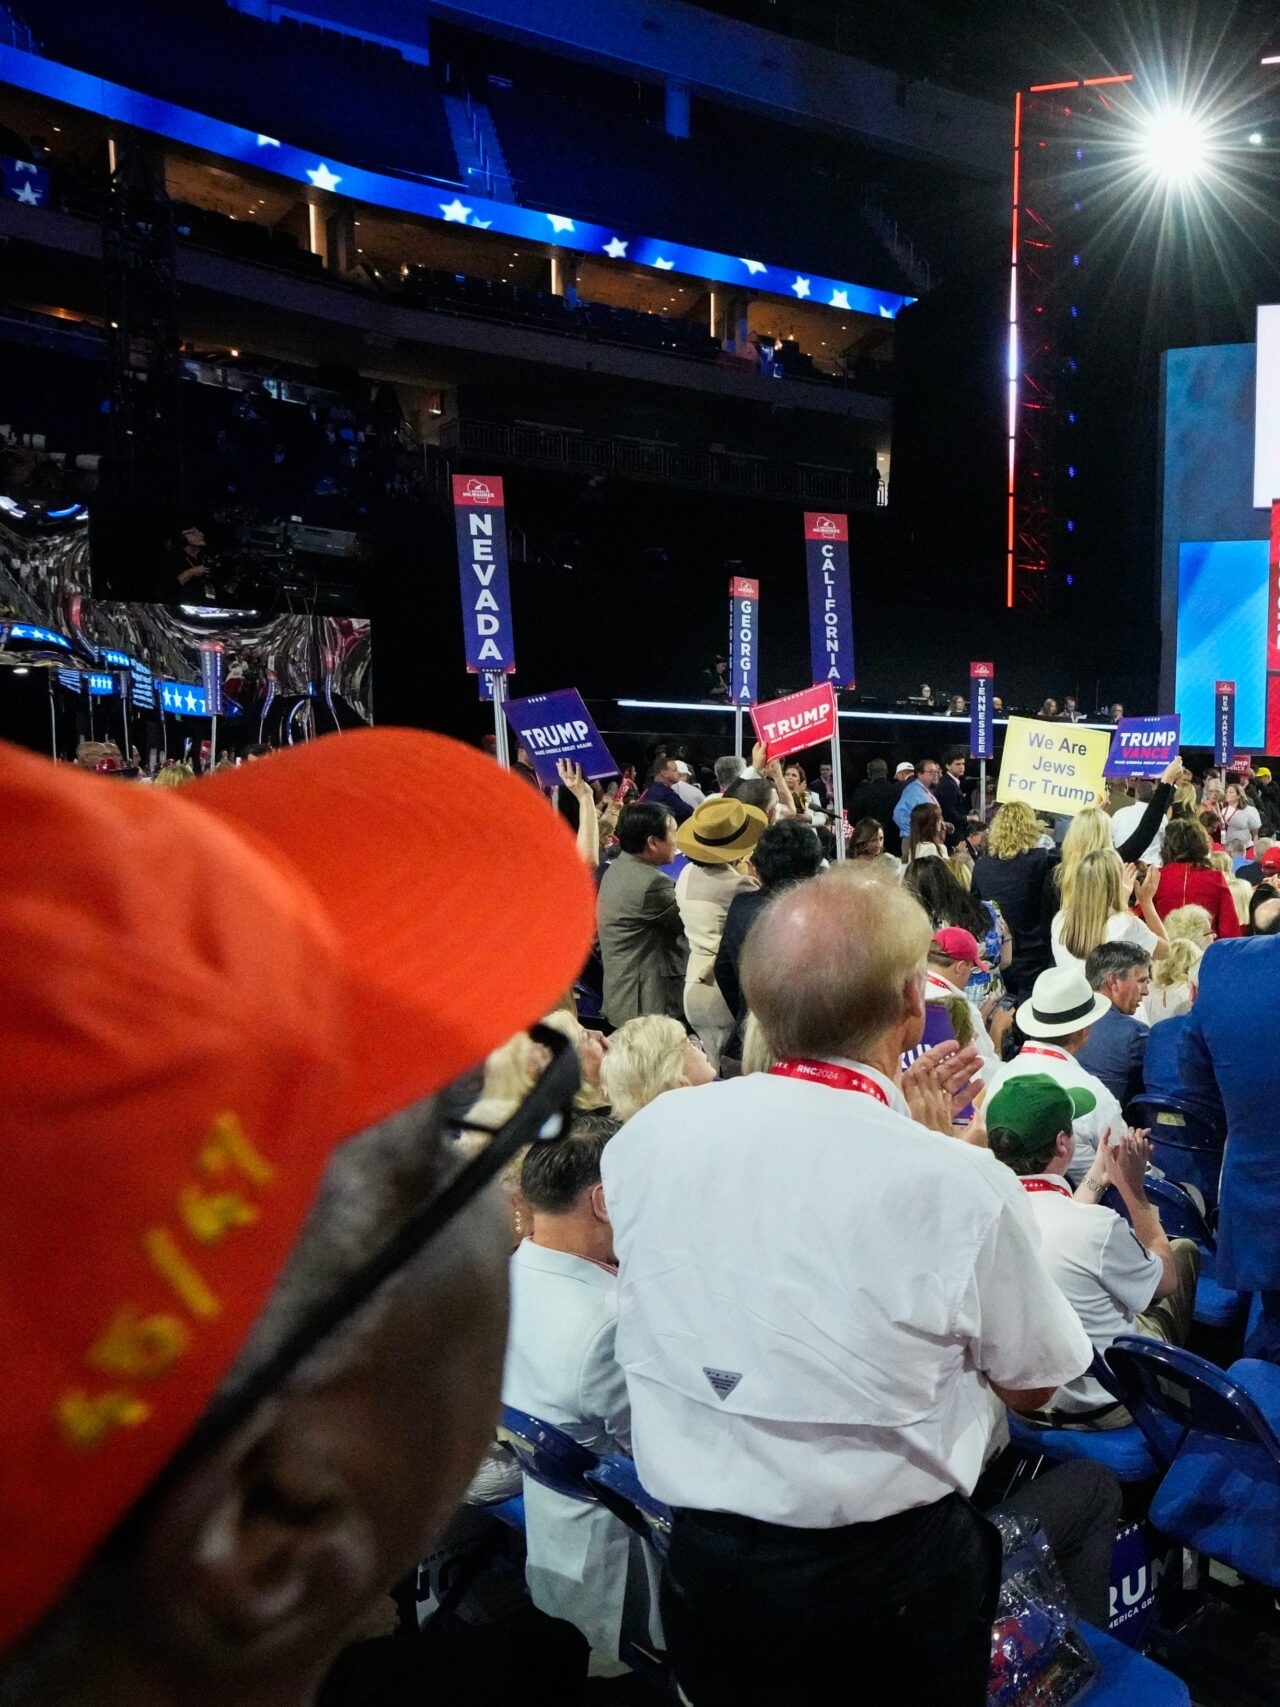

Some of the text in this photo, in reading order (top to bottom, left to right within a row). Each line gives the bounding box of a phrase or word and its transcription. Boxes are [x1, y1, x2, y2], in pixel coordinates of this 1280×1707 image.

[469, 513, 503, 660] NEVADA
[821, 544, 841, 679] CALIFORNIA
[740, 600, 752, 699] GEORGIA
[977, 679, 986, 753] TENNESSEE
[1221, 695, 1229, 712] NEW
[520, 720, 589, 750] TRUMP
[763, 703, 831, 739] TRUMP
[1028, 731, 1087, 756] We Are
[1120, 730, 1176, 747] TRUMP
[1122, 747, 1170, 760] VANCE
[1033, 756, 1075, 777] Jews
[1008, 773, 1095, 804] For Trump
[1108, 1606, 1139, 1630] MERICA
